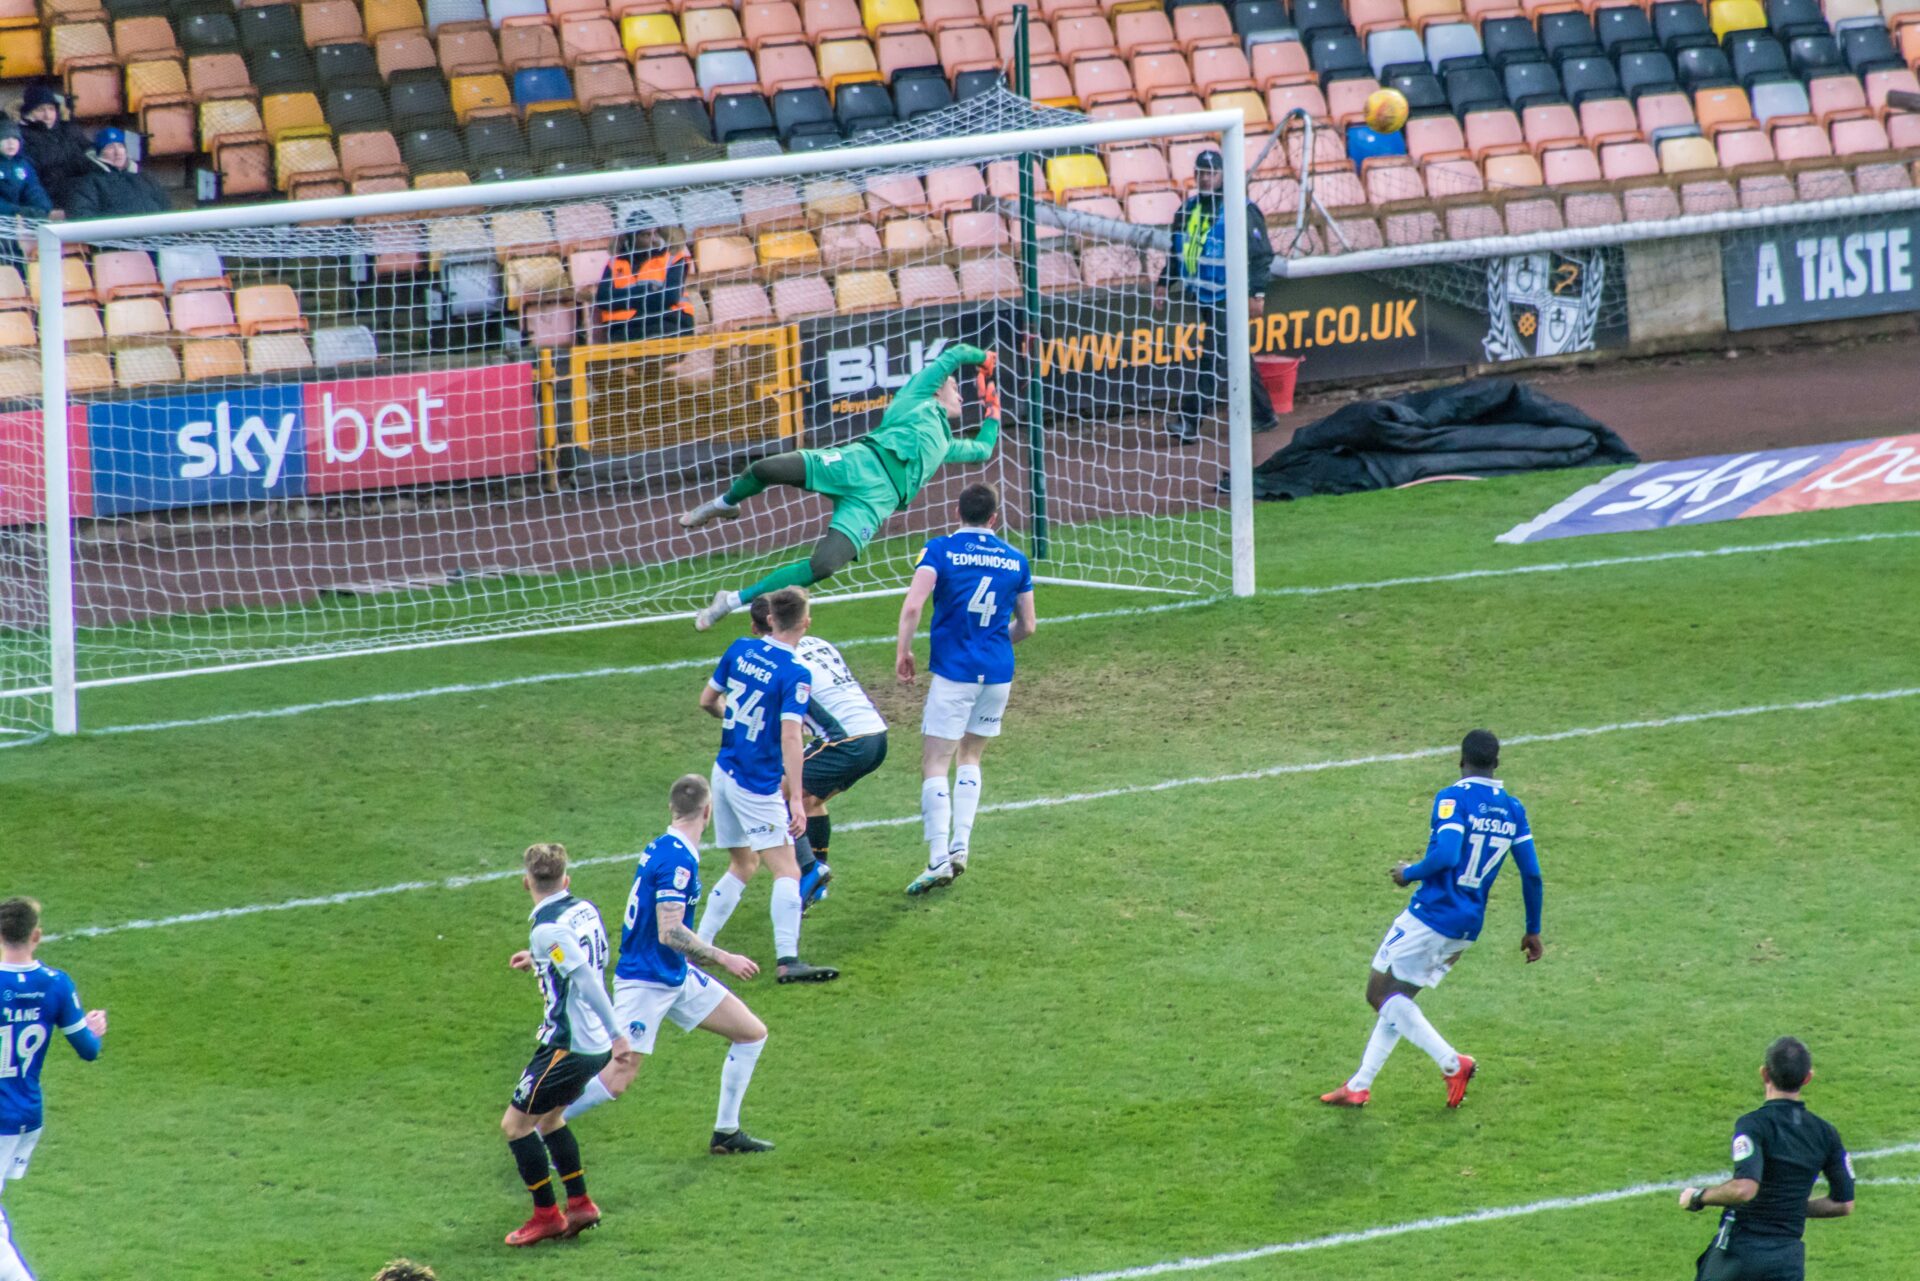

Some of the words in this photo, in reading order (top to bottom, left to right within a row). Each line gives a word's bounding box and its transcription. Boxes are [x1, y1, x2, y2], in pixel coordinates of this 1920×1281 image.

[1757, 242, 1785, 307] A
[1796, 228, 1912, 302] TASTE
[827, 337, 949, 395] BLK
[176, 401, 296, 488] sky
[322, 387, 445, 464] bet
[1592, 452, 1821, 519] sky
[952, 553, 1020, 572] EDMUNDSON
[967, 575, 997, 627] 4
[737, 659, 772, 685] HAMER
[722, 676, 766, 743] 34
[1457, 833, 1512, 889] 17
[6, 1007, 41, 1022] LANG
[0, 1023, 47, 1079] 19
